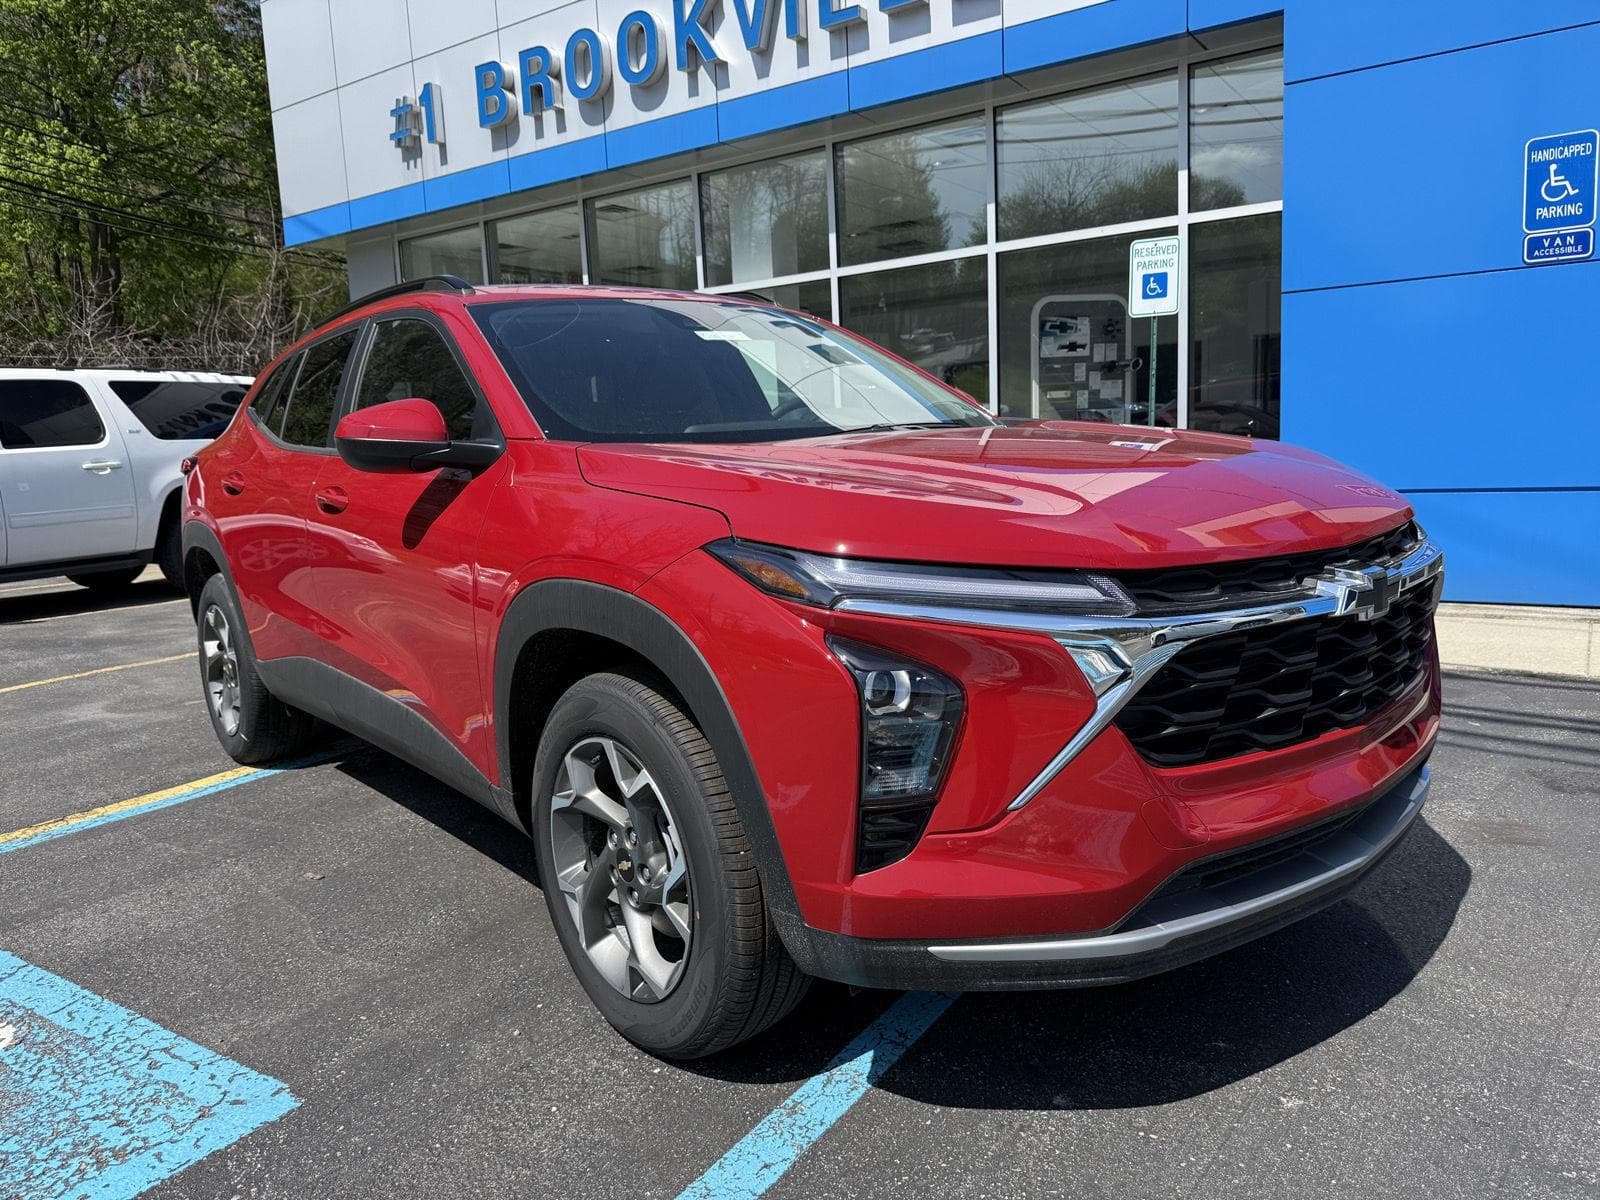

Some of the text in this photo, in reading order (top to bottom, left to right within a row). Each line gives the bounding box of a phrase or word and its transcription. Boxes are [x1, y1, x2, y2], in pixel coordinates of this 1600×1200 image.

[389, 82, 444, 146] #1
[1531, 142, 1592, 162] HANDICAPPED
[1536, 203, 1583, 219] PARKING
[1543, 235, 1574, 247] VAN
[1134, 244, 1177, 258] RESERVED
[1534, 245, 1583, 256] ACCESSIBLE
[1136, 258, 1174, 271] PARKING
